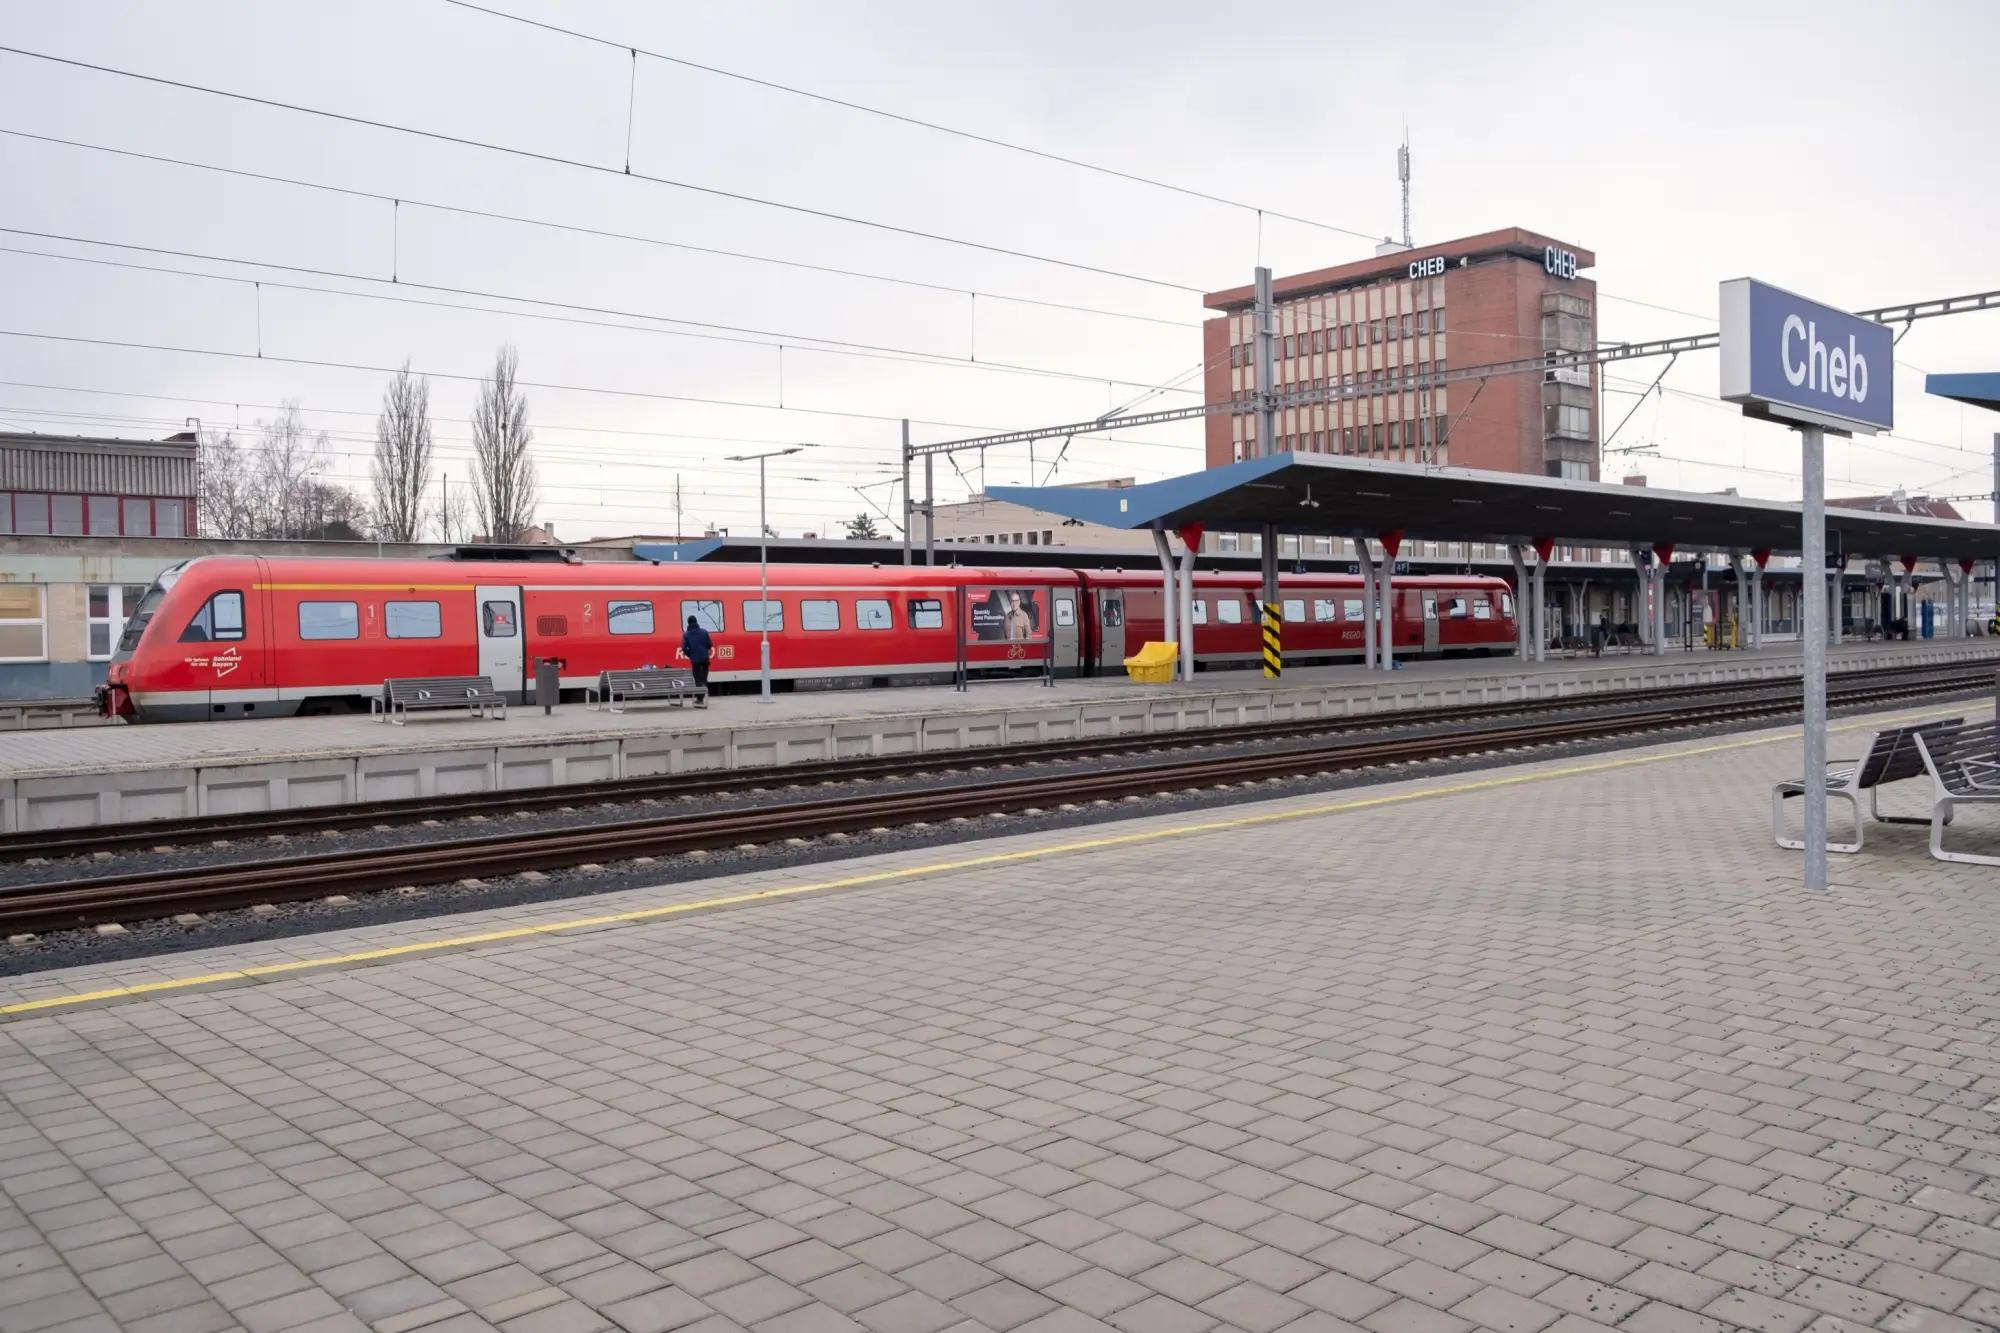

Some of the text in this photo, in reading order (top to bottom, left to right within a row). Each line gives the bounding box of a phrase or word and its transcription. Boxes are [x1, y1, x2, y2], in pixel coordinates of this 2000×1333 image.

[1409, 256, 1445, 278] CHEB
[1545, 245, 1577, 280] CHEB
[1782, 314, 1868, 403] Cheb
[368, 604, 374, 618] 1
[584, 603, 592, 616] 2
[719, 647, 733, 658] DB
